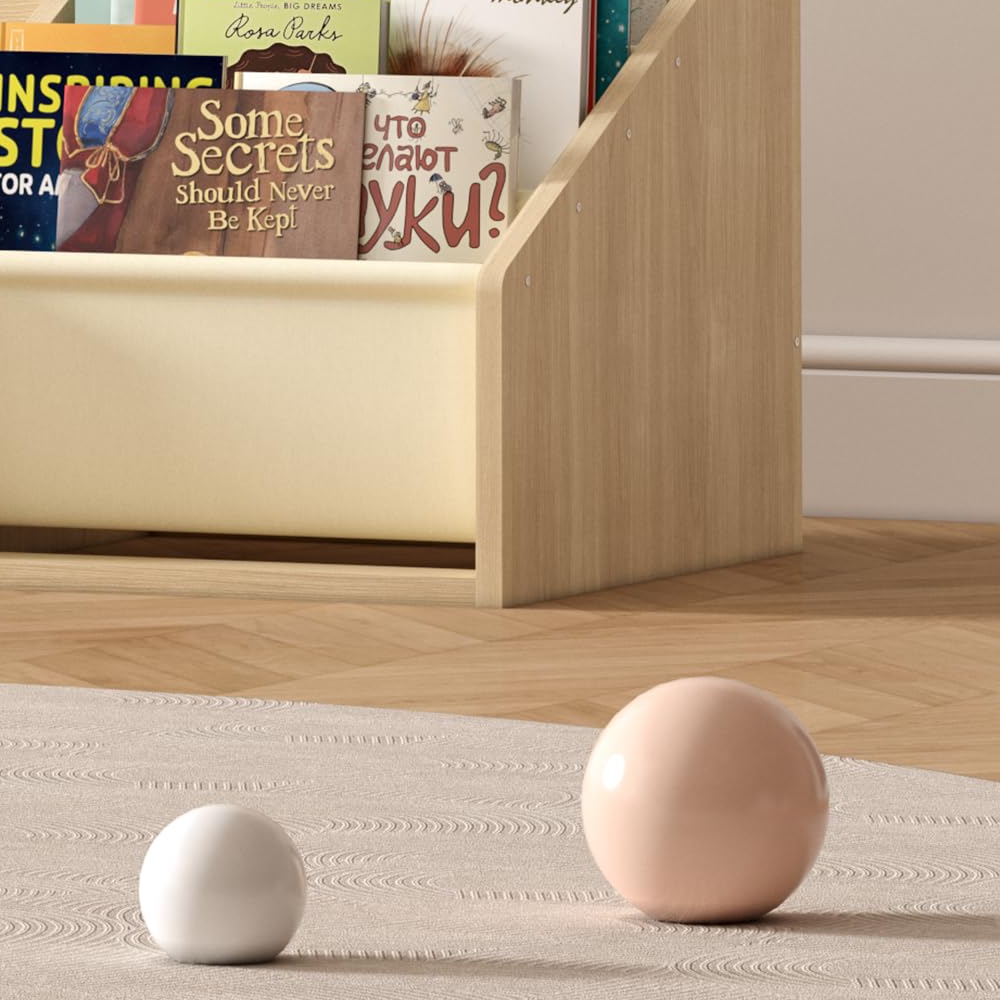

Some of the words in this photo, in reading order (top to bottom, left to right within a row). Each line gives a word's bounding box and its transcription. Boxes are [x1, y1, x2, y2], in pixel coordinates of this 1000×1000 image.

[283, 2, 300, 10] BIG
[303, 2, 343, 11] DREAMS
[225, 13, 281, 39] Rosa
[283, 14, 343, 41] Parks
[197, 99, 304, 141] Some
[171, 132, 335, 177] Secrets
[175, 178, 261, 205] Should
[269, 181, 335, 202] Never
[207, 209, 240, 231] Be
[246, 204, 299, 237] Kept
